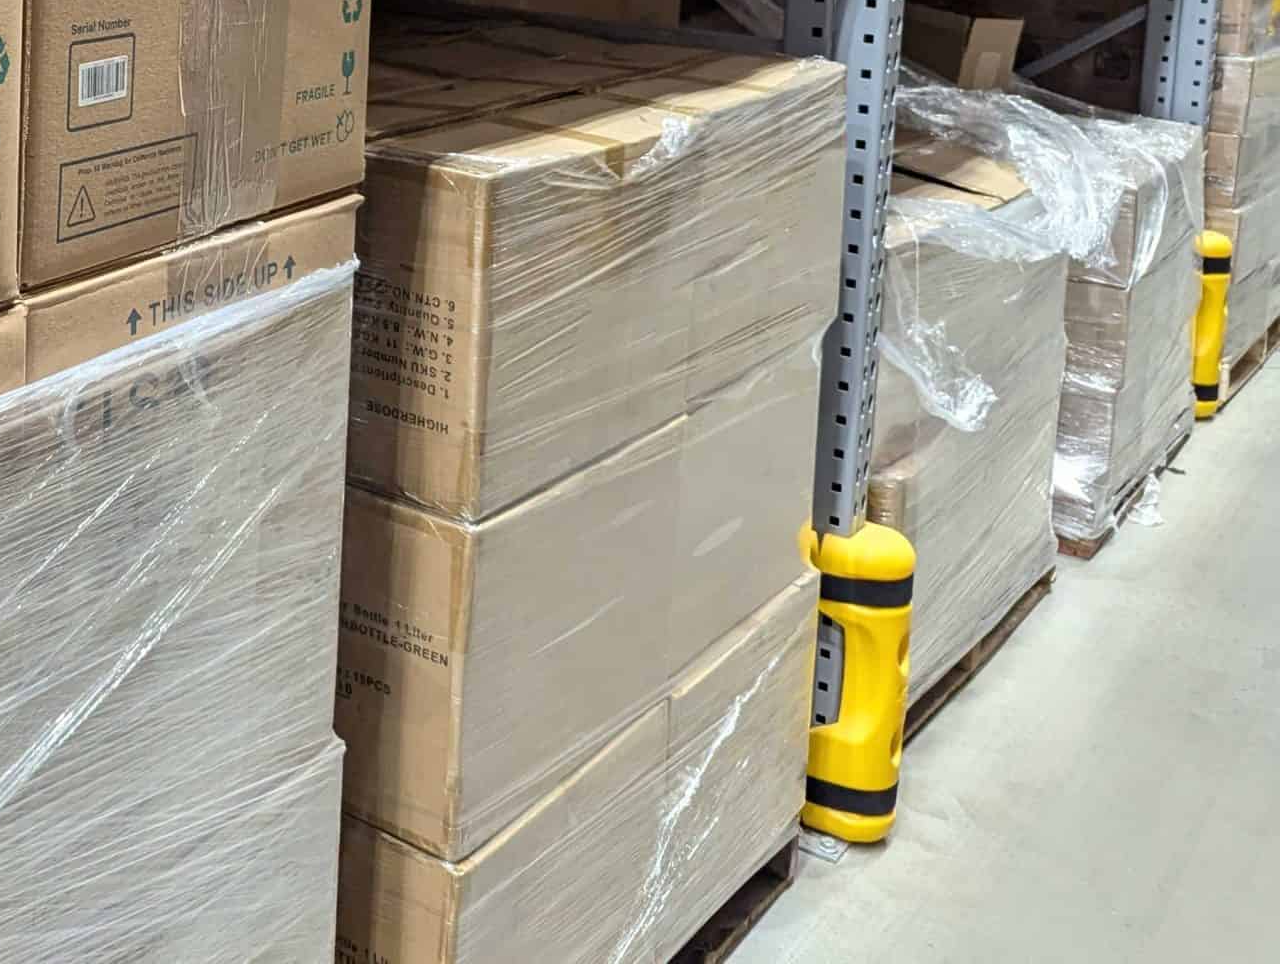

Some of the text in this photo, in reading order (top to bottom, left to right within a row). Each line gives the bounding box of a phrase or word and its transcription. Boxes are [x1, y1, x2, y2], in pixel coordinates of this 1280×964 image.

[71, 17, 131, 36] Serial Number
[295, 83, 336, 106] FRAGILE
[288, 135, 310, 154] GET
[311, 130, 333, 148] WET
[149, 261, 279, 327] THIS SIDE UP
[443, 317, 455, 330] 5.
[441, 335, 454, 347] 4.
[440, 352, 453, 365] 3.
[410, 361, 438, 378] SKU
[440, 370, 452, 382] 2.
[366, 400, 449, 435] HIGHERDOSE
